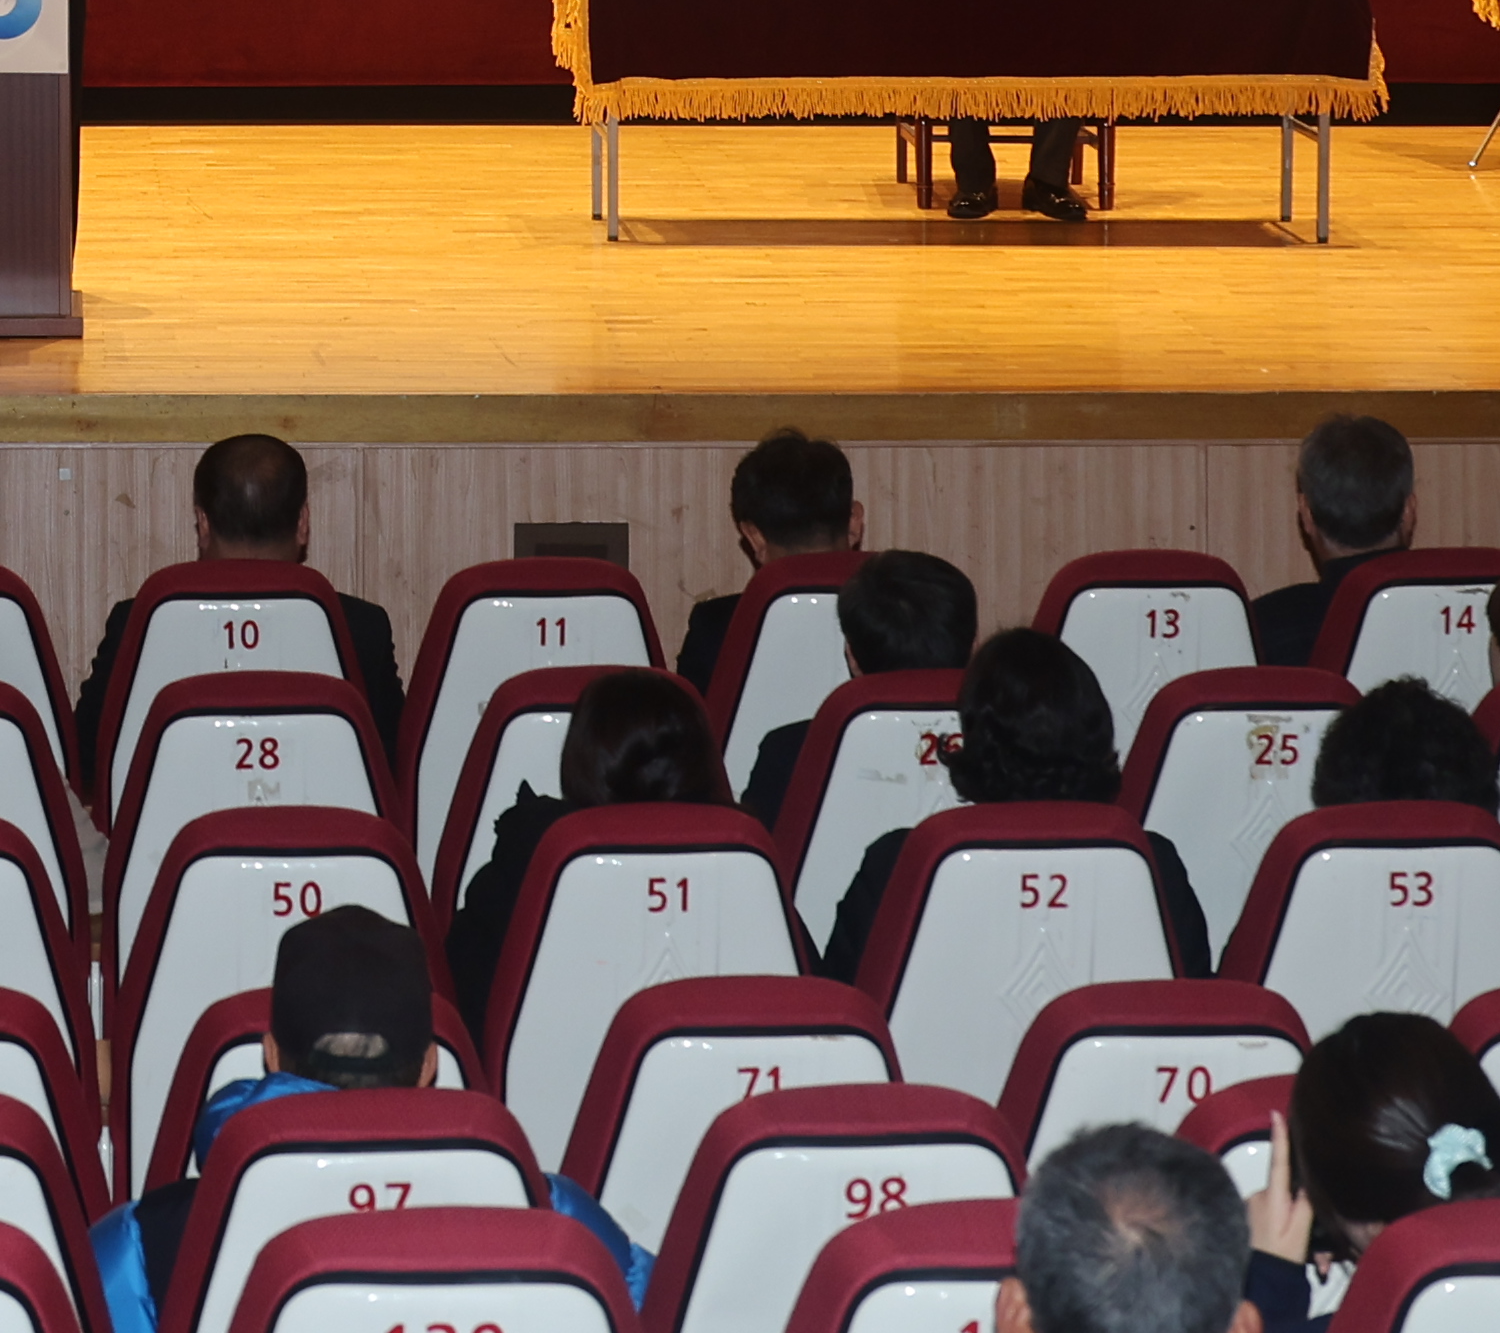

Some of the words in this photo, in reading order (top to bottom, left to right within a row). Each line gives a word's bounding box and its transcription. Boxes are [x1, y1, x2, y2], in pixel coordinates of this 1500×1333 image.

[225, 620, 260, 649] 10
[537, 618, 566, 645] 11
[1148, 609, 1180, 639] 13
[1441, 605, 1477, 635] 14
[237, 737, 280, 770] 28
[1255, 731, 1298, 765] 25
[273, 880, 322, 917] 50
[649, 878, 689, 913] 51
[1022, 874, 1068, 909] 52
[1391, 872, 1433, 907] 53
[1156, 1065, 1212, 1104] 70
[846, 1176, 908, 1221] 98
